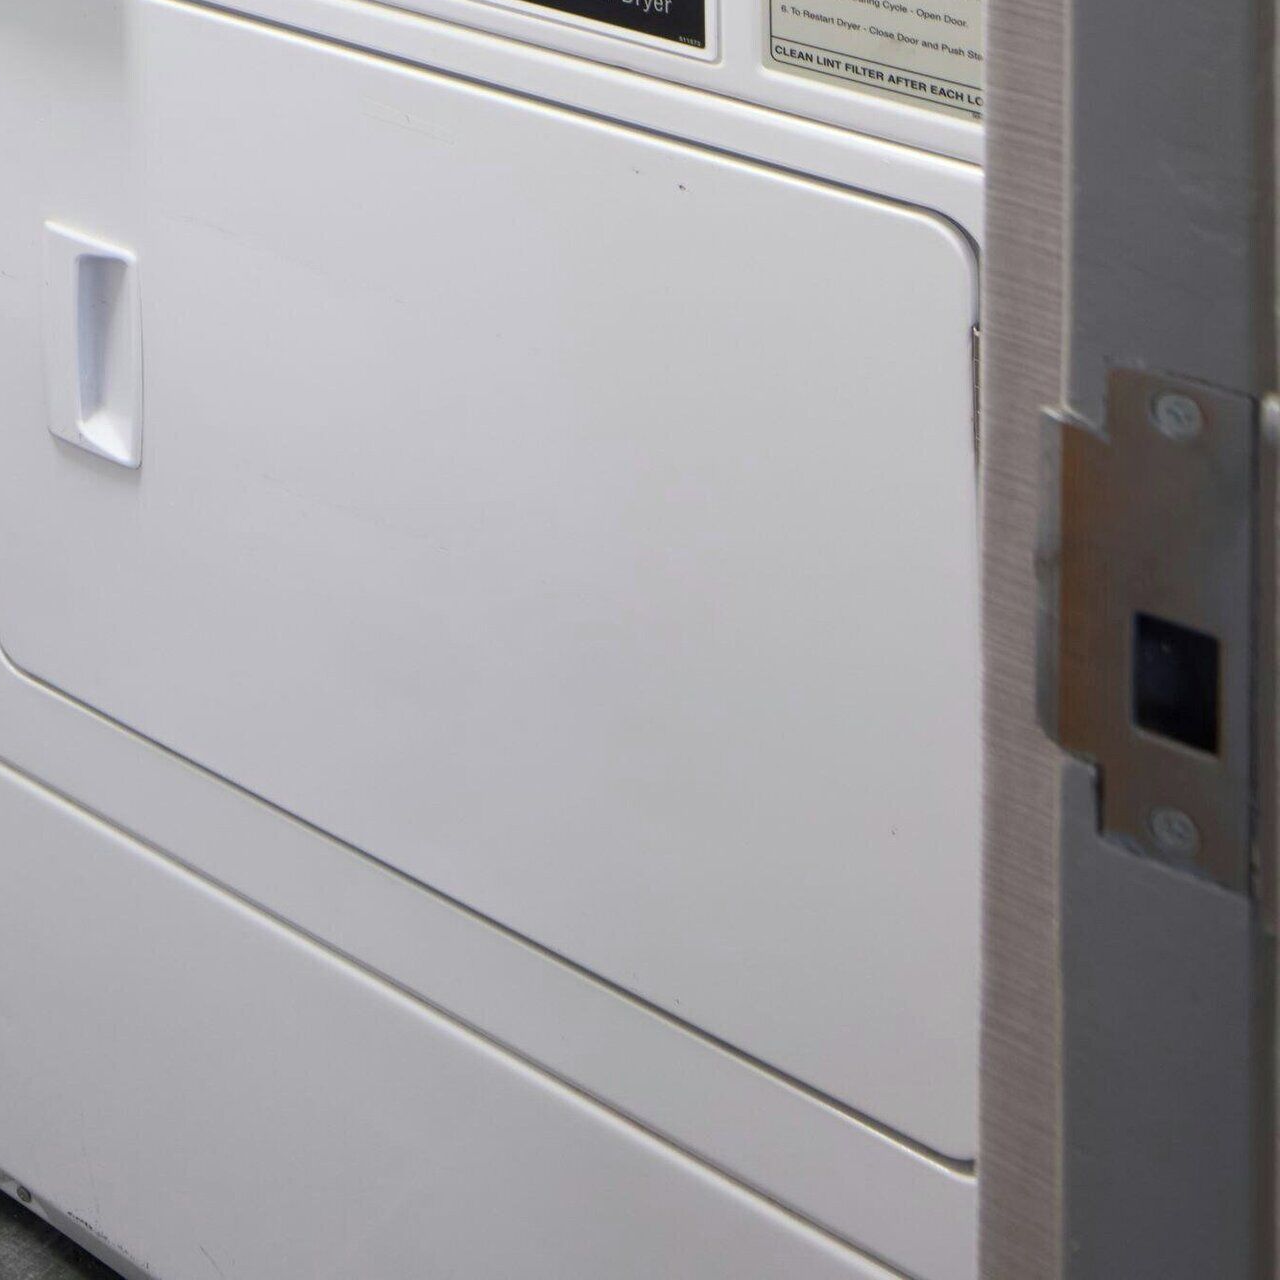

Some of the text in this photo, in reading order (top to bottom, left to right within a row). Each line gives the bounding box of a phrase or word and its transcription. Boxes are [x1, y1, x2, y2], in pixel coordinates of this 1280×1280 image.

[780, 4, 789, 14] 6.
[791, 6, 801, 17] To
[803, 9, 835, 25] Restart
[837, 17, 861, 32] Dryer
[869, 25, 895, 40] Close
[897, 32, 919, 46] Door
[921, 39, 938, 51] and
[941, 43, 965, 57] Push
[882, 0, 908, 14] Cycle
[916, 8, 941, 22] Open
[944, 14, 968, 28] Door.
[775, 45, 814, 63] CLEAN
[816, 55, 841, 70] LINT
[845, 62, 885, 81] FILTER
[888, 73, 927, 93] AFTER
[930, 85, 964, 103] EACH
